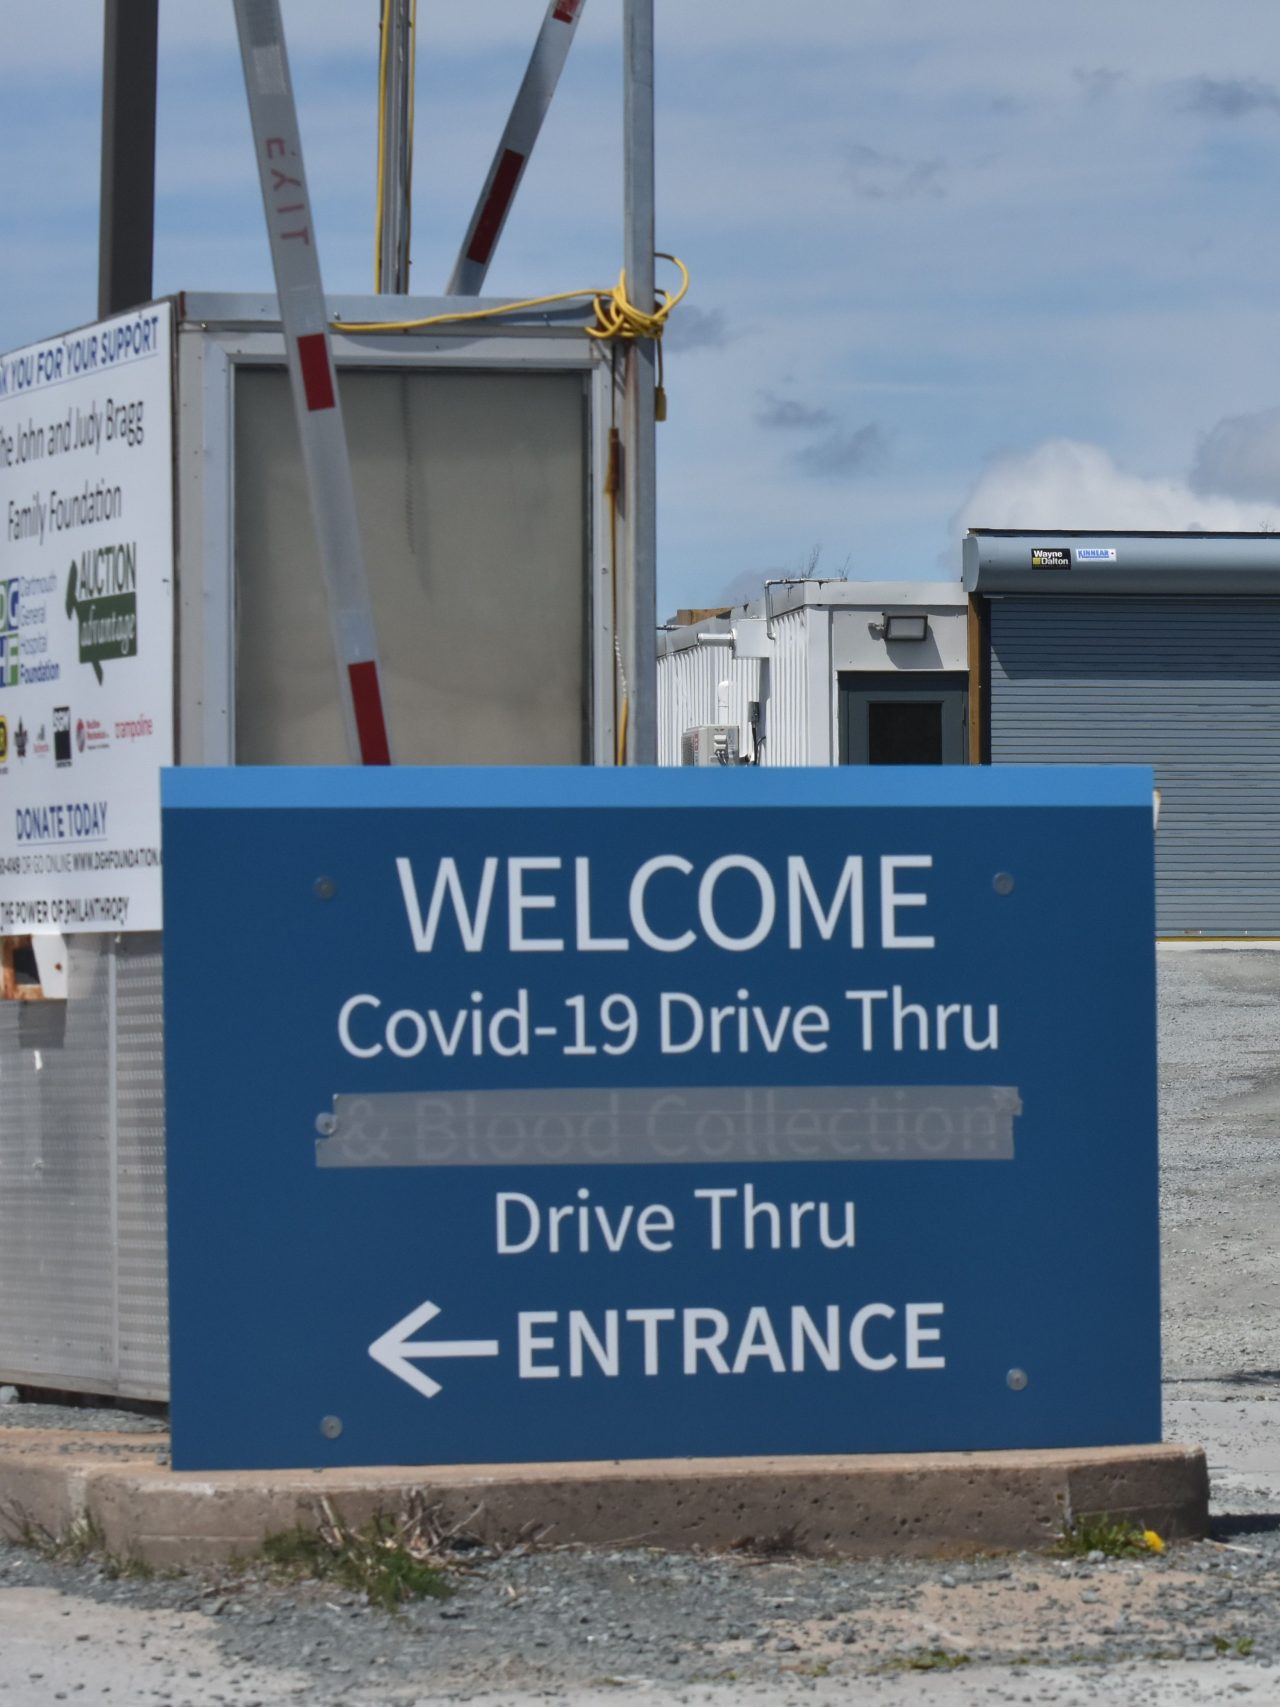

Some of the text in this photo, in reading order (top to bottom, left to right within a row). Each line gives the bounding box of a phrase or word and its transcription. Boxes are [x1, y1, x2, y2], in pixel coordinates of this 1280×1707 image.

[11, 354, 34, 392] YOU
[37, 346, 63, 384] FOR
[66, 335, 97, 375] YOUR
[101, 316, 158, 364] SUPPORT
[16, 416, 44, 463] John
[48, 406, 72, 455] and
[74, 399, 102, 455] Judy
[106, 398, 143, 446] Bragg
[8, 477, 121, 546] Family Foundation
[78, 541, 136, 599] AUCTION
[1034, 550, 1062, 558] Wayne
[20, 659, 60, 684] Foundation
[16, 801, 107, 840] DONATE TODAY
[16, 900, 48, 924] POWER
[51, 899, 63, 922] OF
[64, 896, 130, 926] PHILANTHROPY
[397, 855, 934, 951] WELCOME
[339, 986, 997, 1057] Covid-19 Drive Thru
[497, 1184, 854, 1253] Drive Thru
[519, 1303, 945, 1378] ENTRANCE
